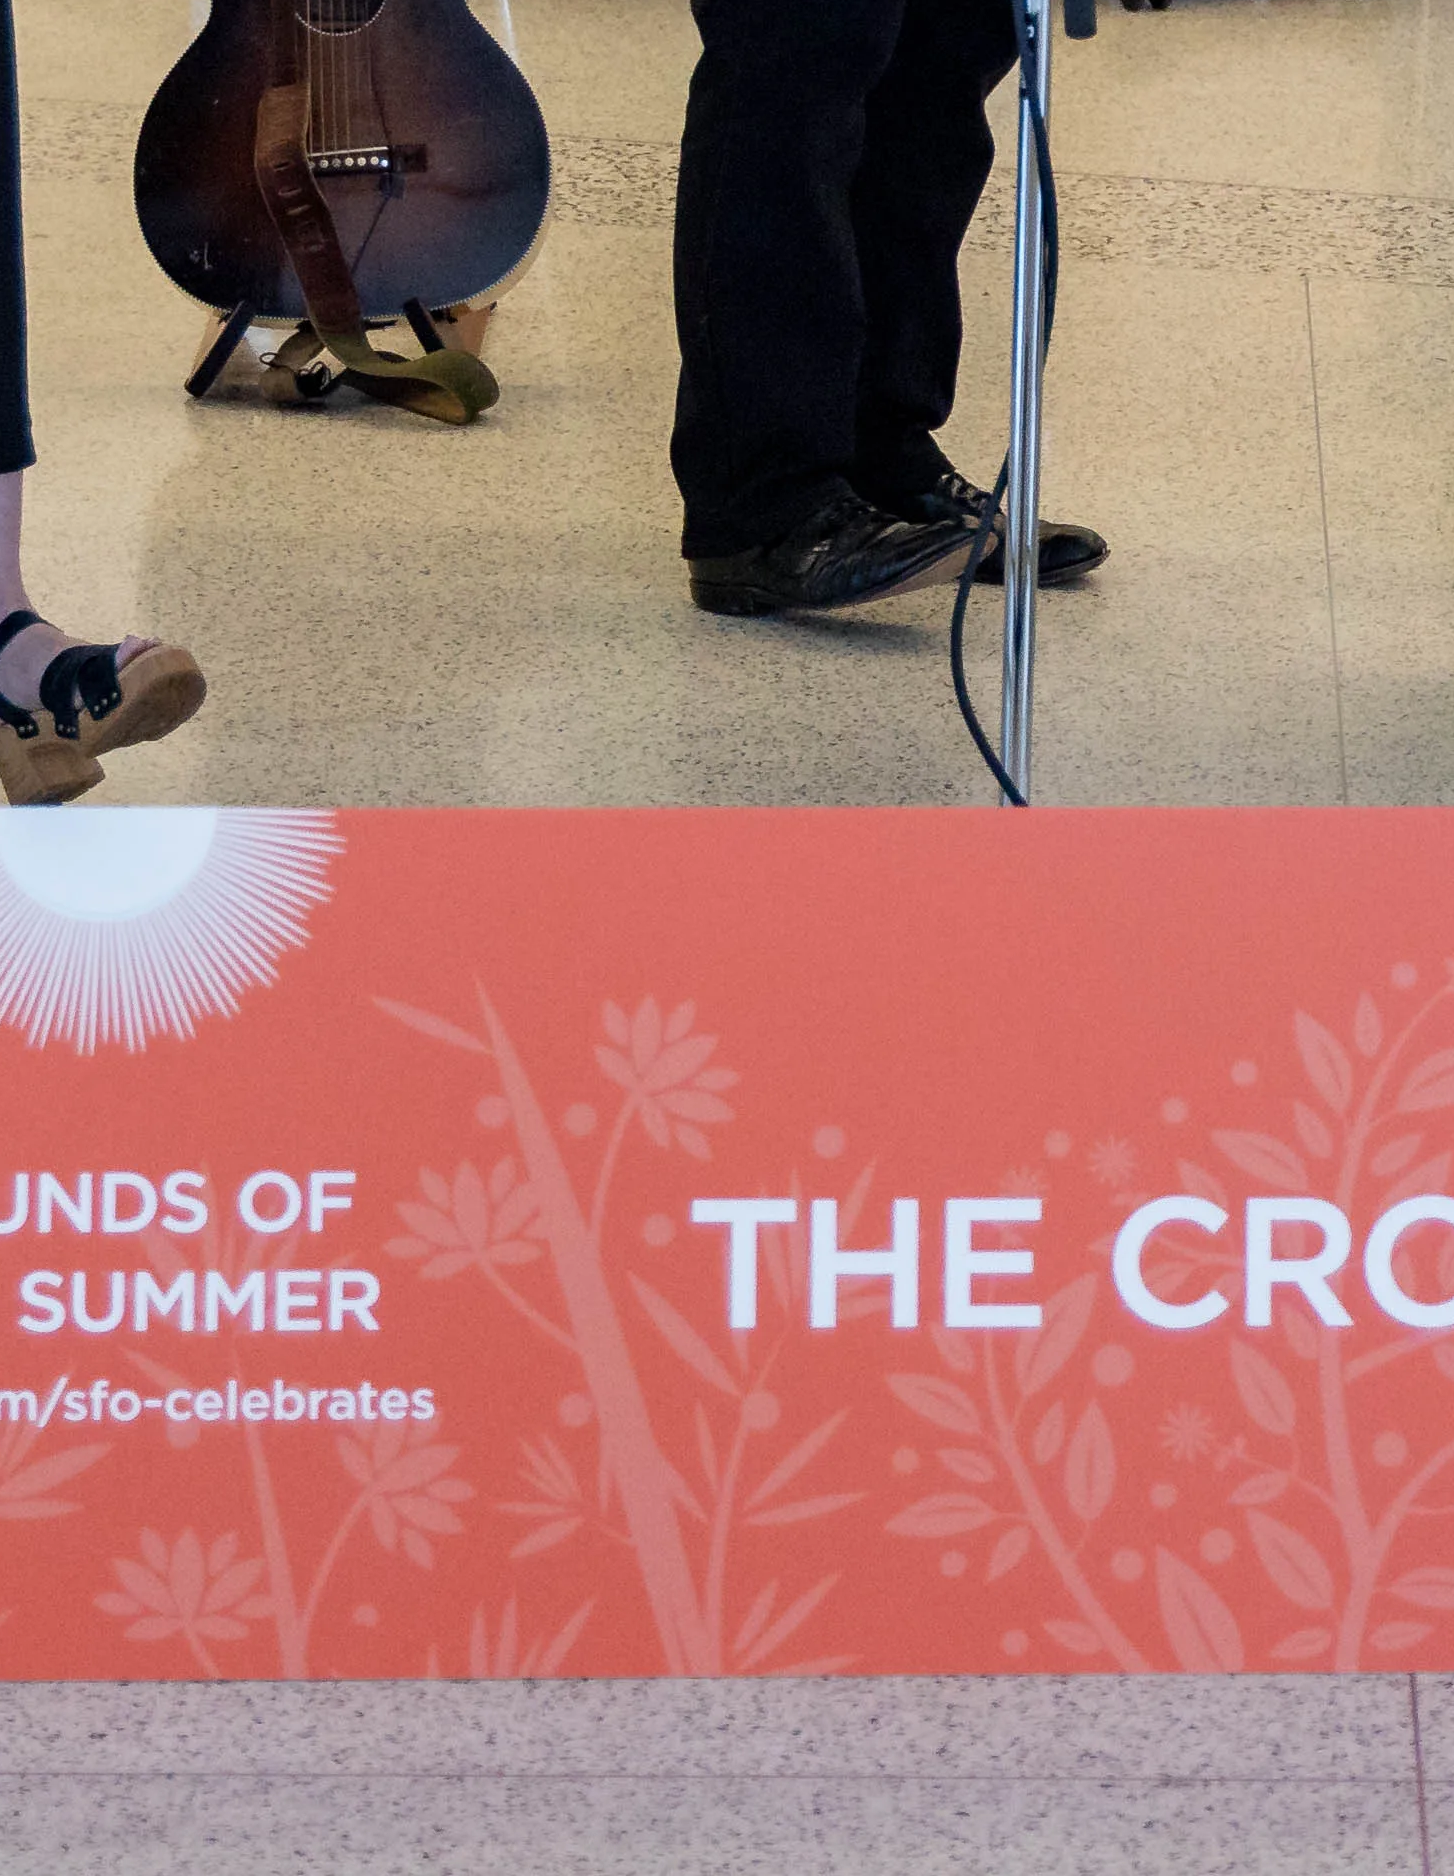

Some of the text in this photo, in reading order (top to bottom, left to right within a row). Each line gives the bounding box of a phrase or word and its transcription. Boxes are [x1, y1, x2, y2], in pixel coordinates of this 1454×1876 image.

[237, 1170, 357, 1236] OF
[690, 1195, 1046, 1331] THE
[18, 1270, 382, 1334] SUMMER
